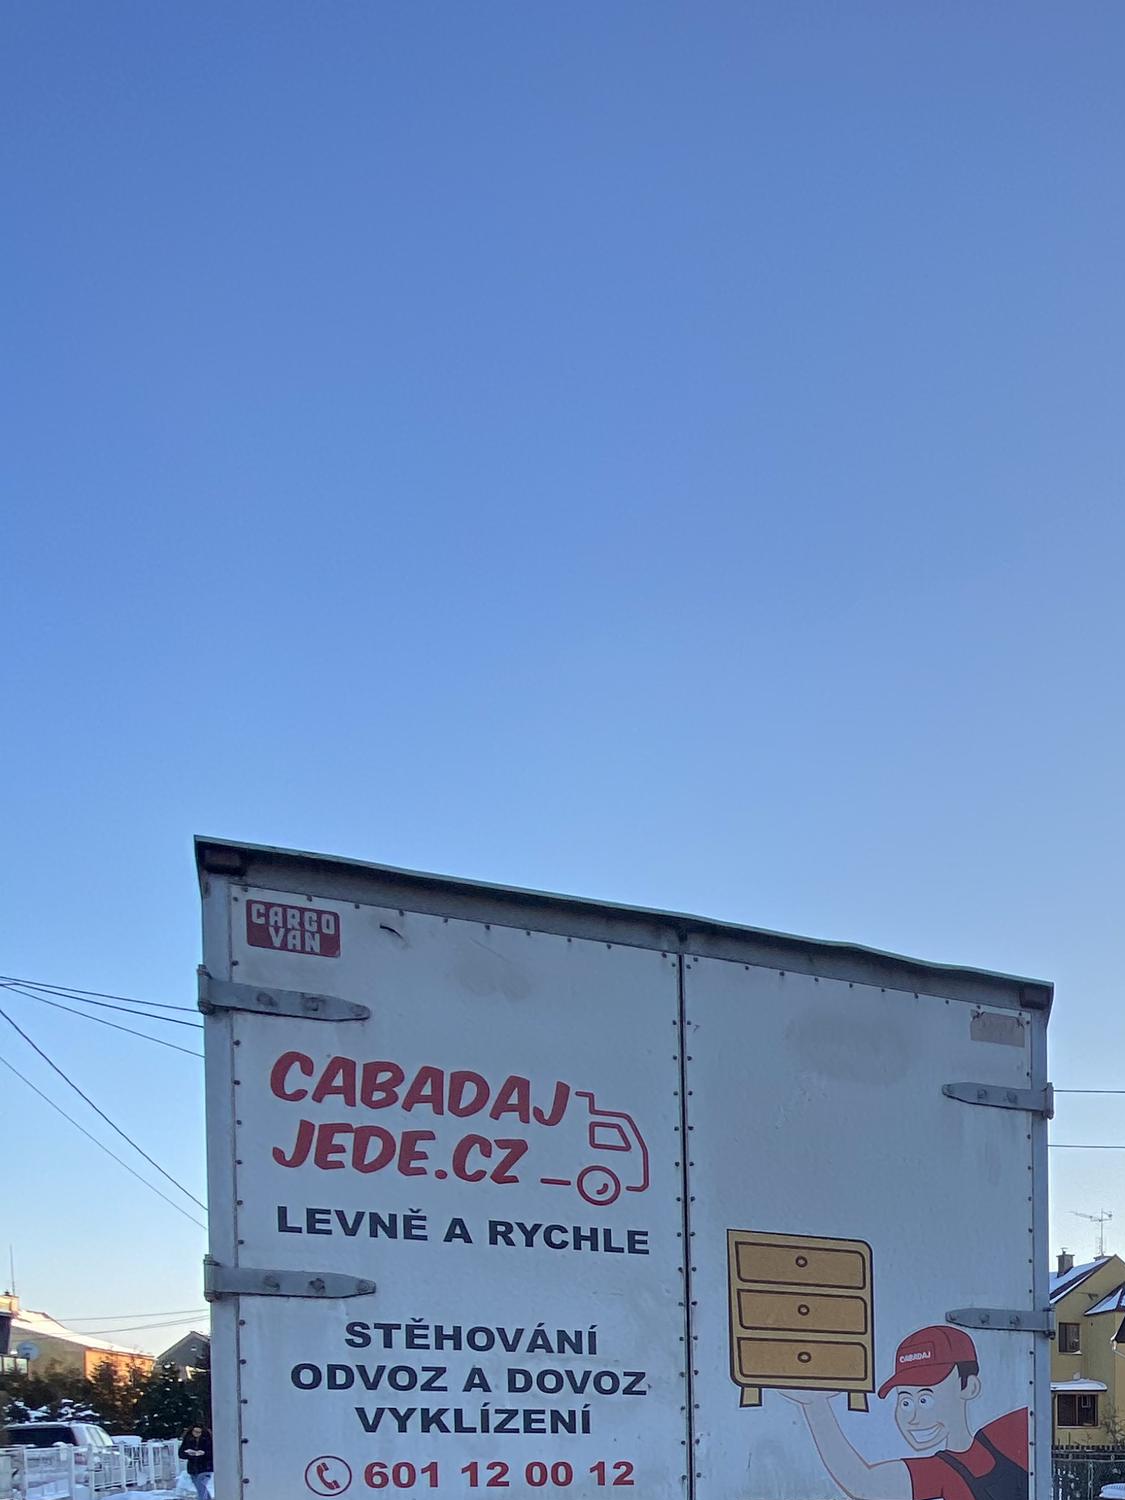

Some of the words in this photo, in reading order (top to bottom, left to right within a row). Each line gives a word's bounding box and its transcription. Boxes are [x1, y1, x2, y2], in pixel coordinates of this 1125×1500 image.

[251, 903, 335, 934] CARGO
[268, 926, 320, 953] VAN
[270, 1050, 571, 1127] CABADAJ
[272, 1119, 529, 1184] JEDE.CZ
[277, 1205, 429, 1242] LEVNĚ
[442, 1217, 473, 1244] A
[488, 1219, 650, 1255] RYCHLE
[344, 1317, 598, 1356] STĚHOVÁNÍ
[899, 1351, 931, 1363] CABADAJ
[290, 1362, 448, 1392] ODVOZ
[462, 1367, 492, 1393] A
[507, 1367, 647, 1396] DOVOZ
[354, 1401, 592, 1434] VYKLÍZENÍ
[363, 1461, 439, 1489] 601
[461, 1461, 510, 1488] 12
[524, 1460, 574, 1487] 00
[589, 1460, 635, 1486] 12
